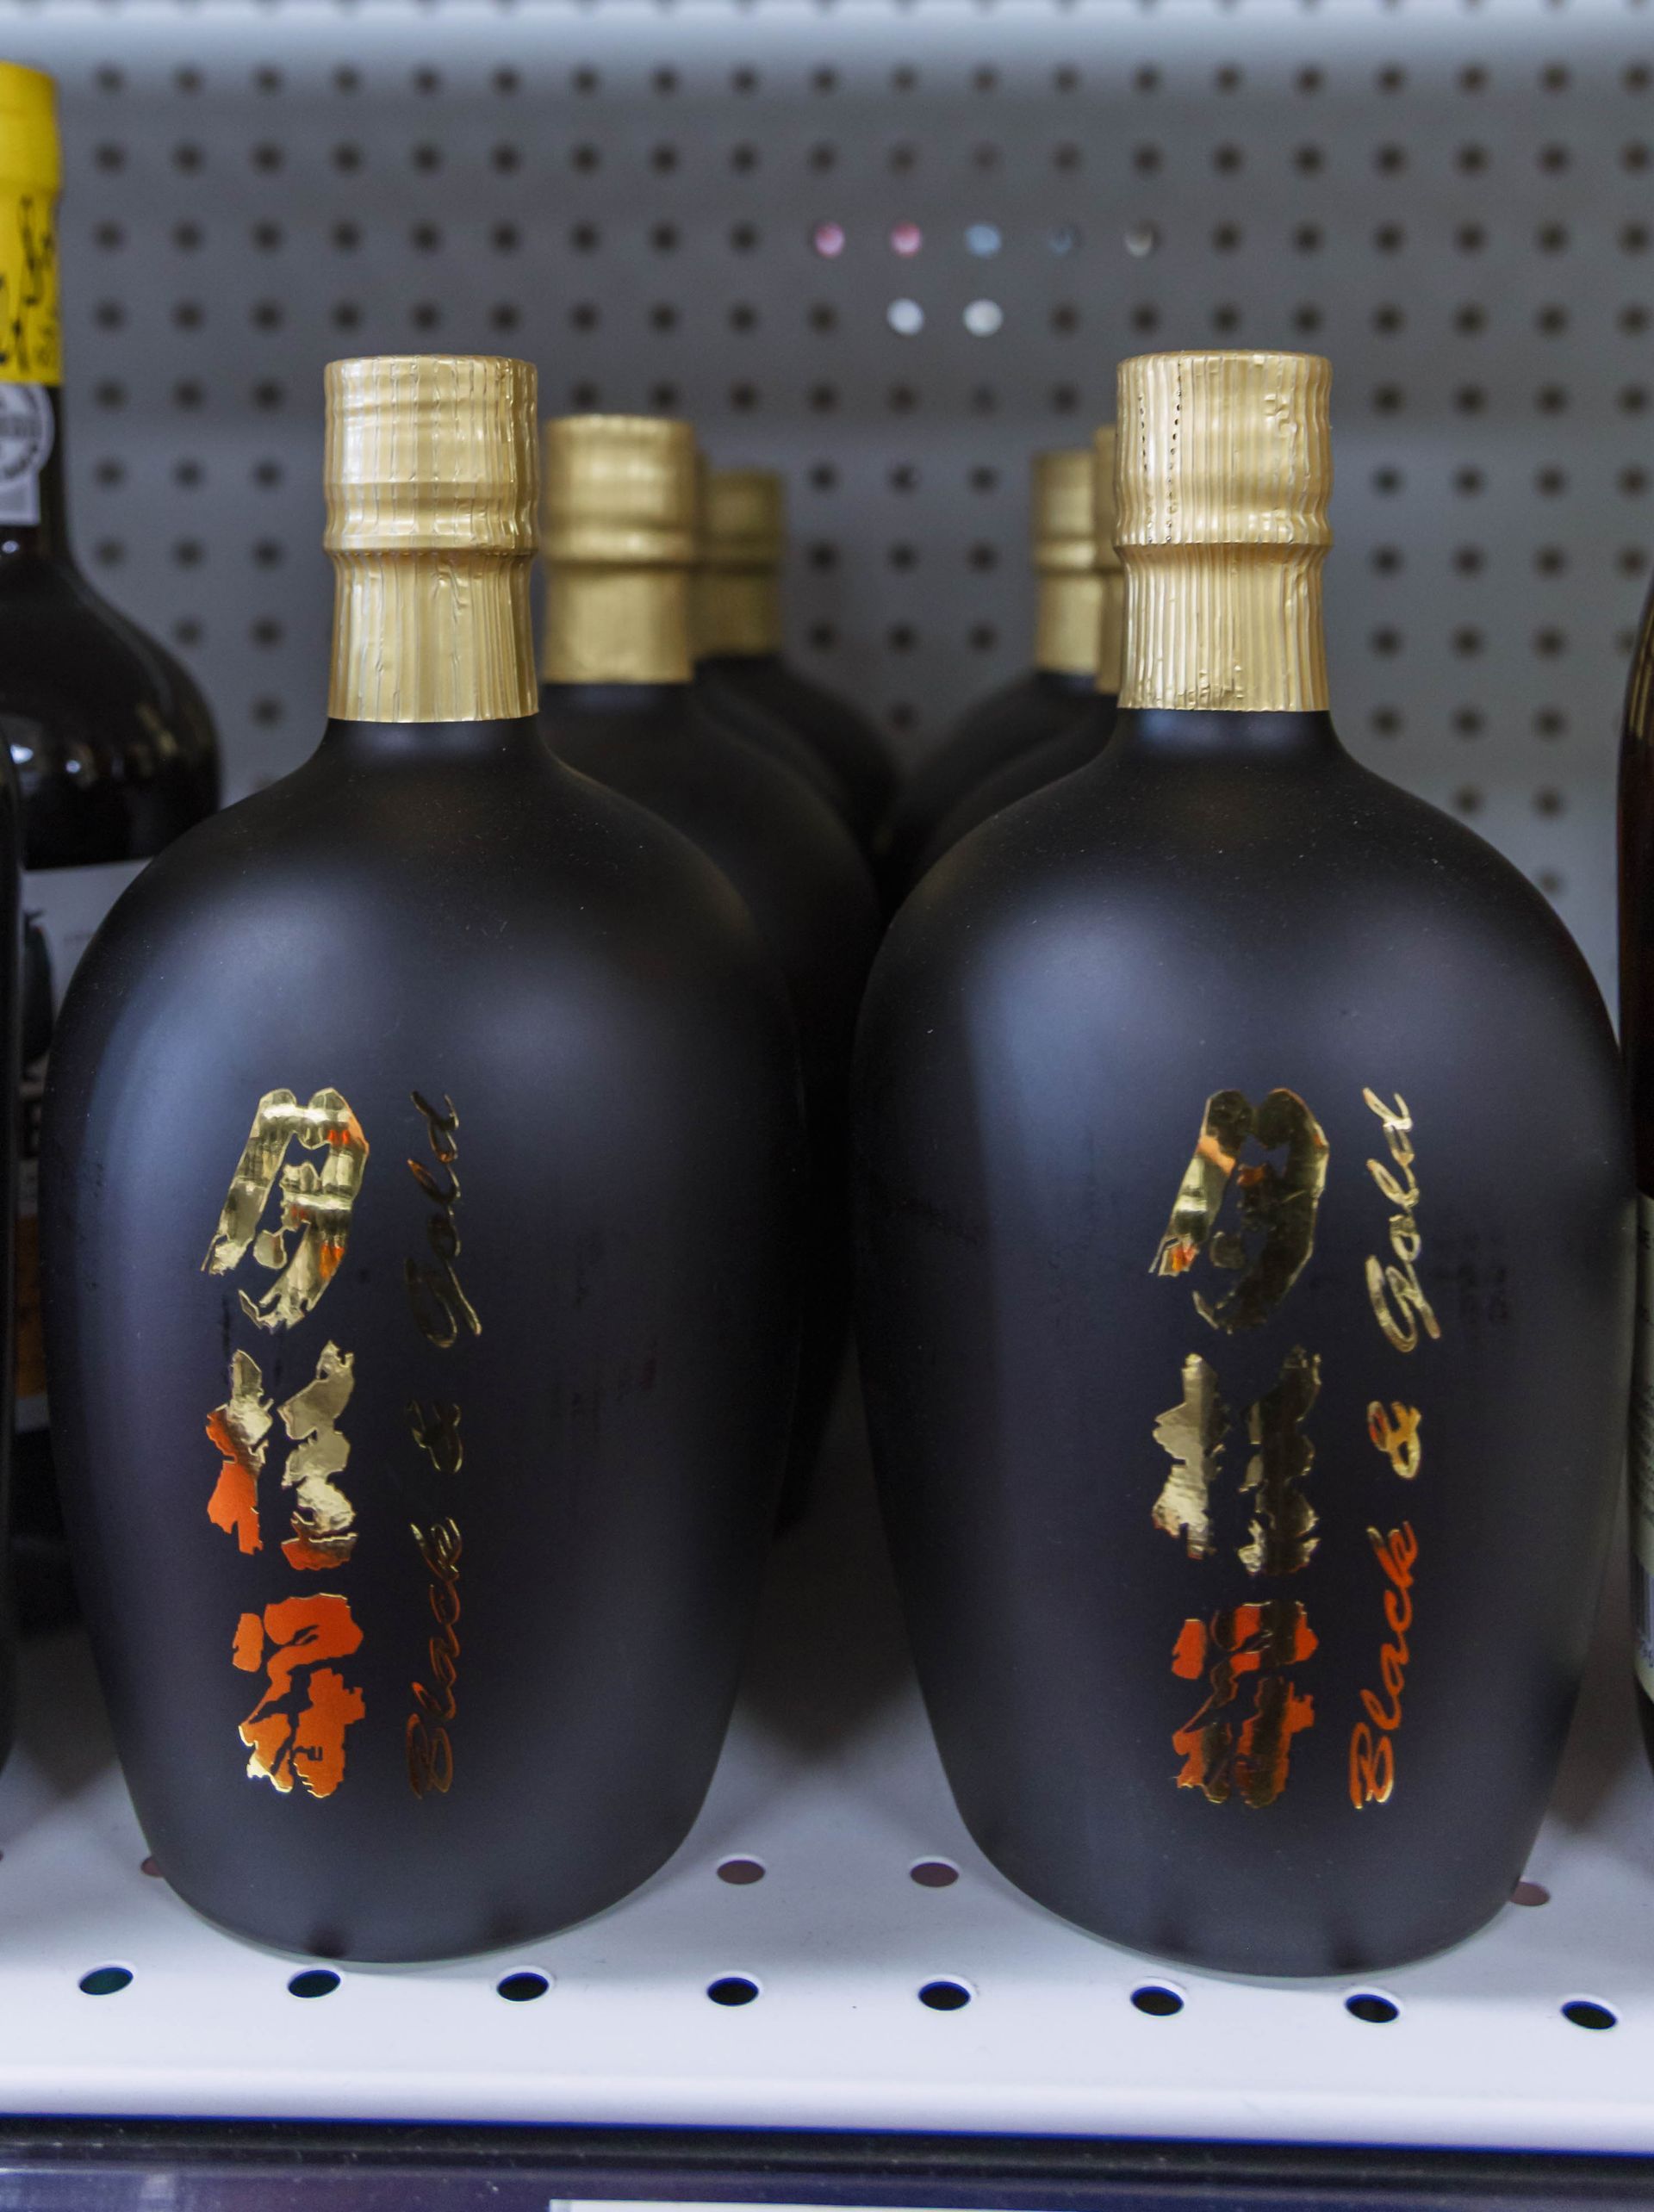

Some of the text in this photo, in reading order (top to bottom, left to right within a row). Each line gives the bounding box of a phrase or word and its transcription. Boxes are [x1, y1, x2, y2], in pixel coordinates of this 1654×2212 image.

[404, 1089, 482, 1349] Gold
[1348, 1086, 1440, 1811] Black & Gold
[406, 1514, 463, 1799] Black
